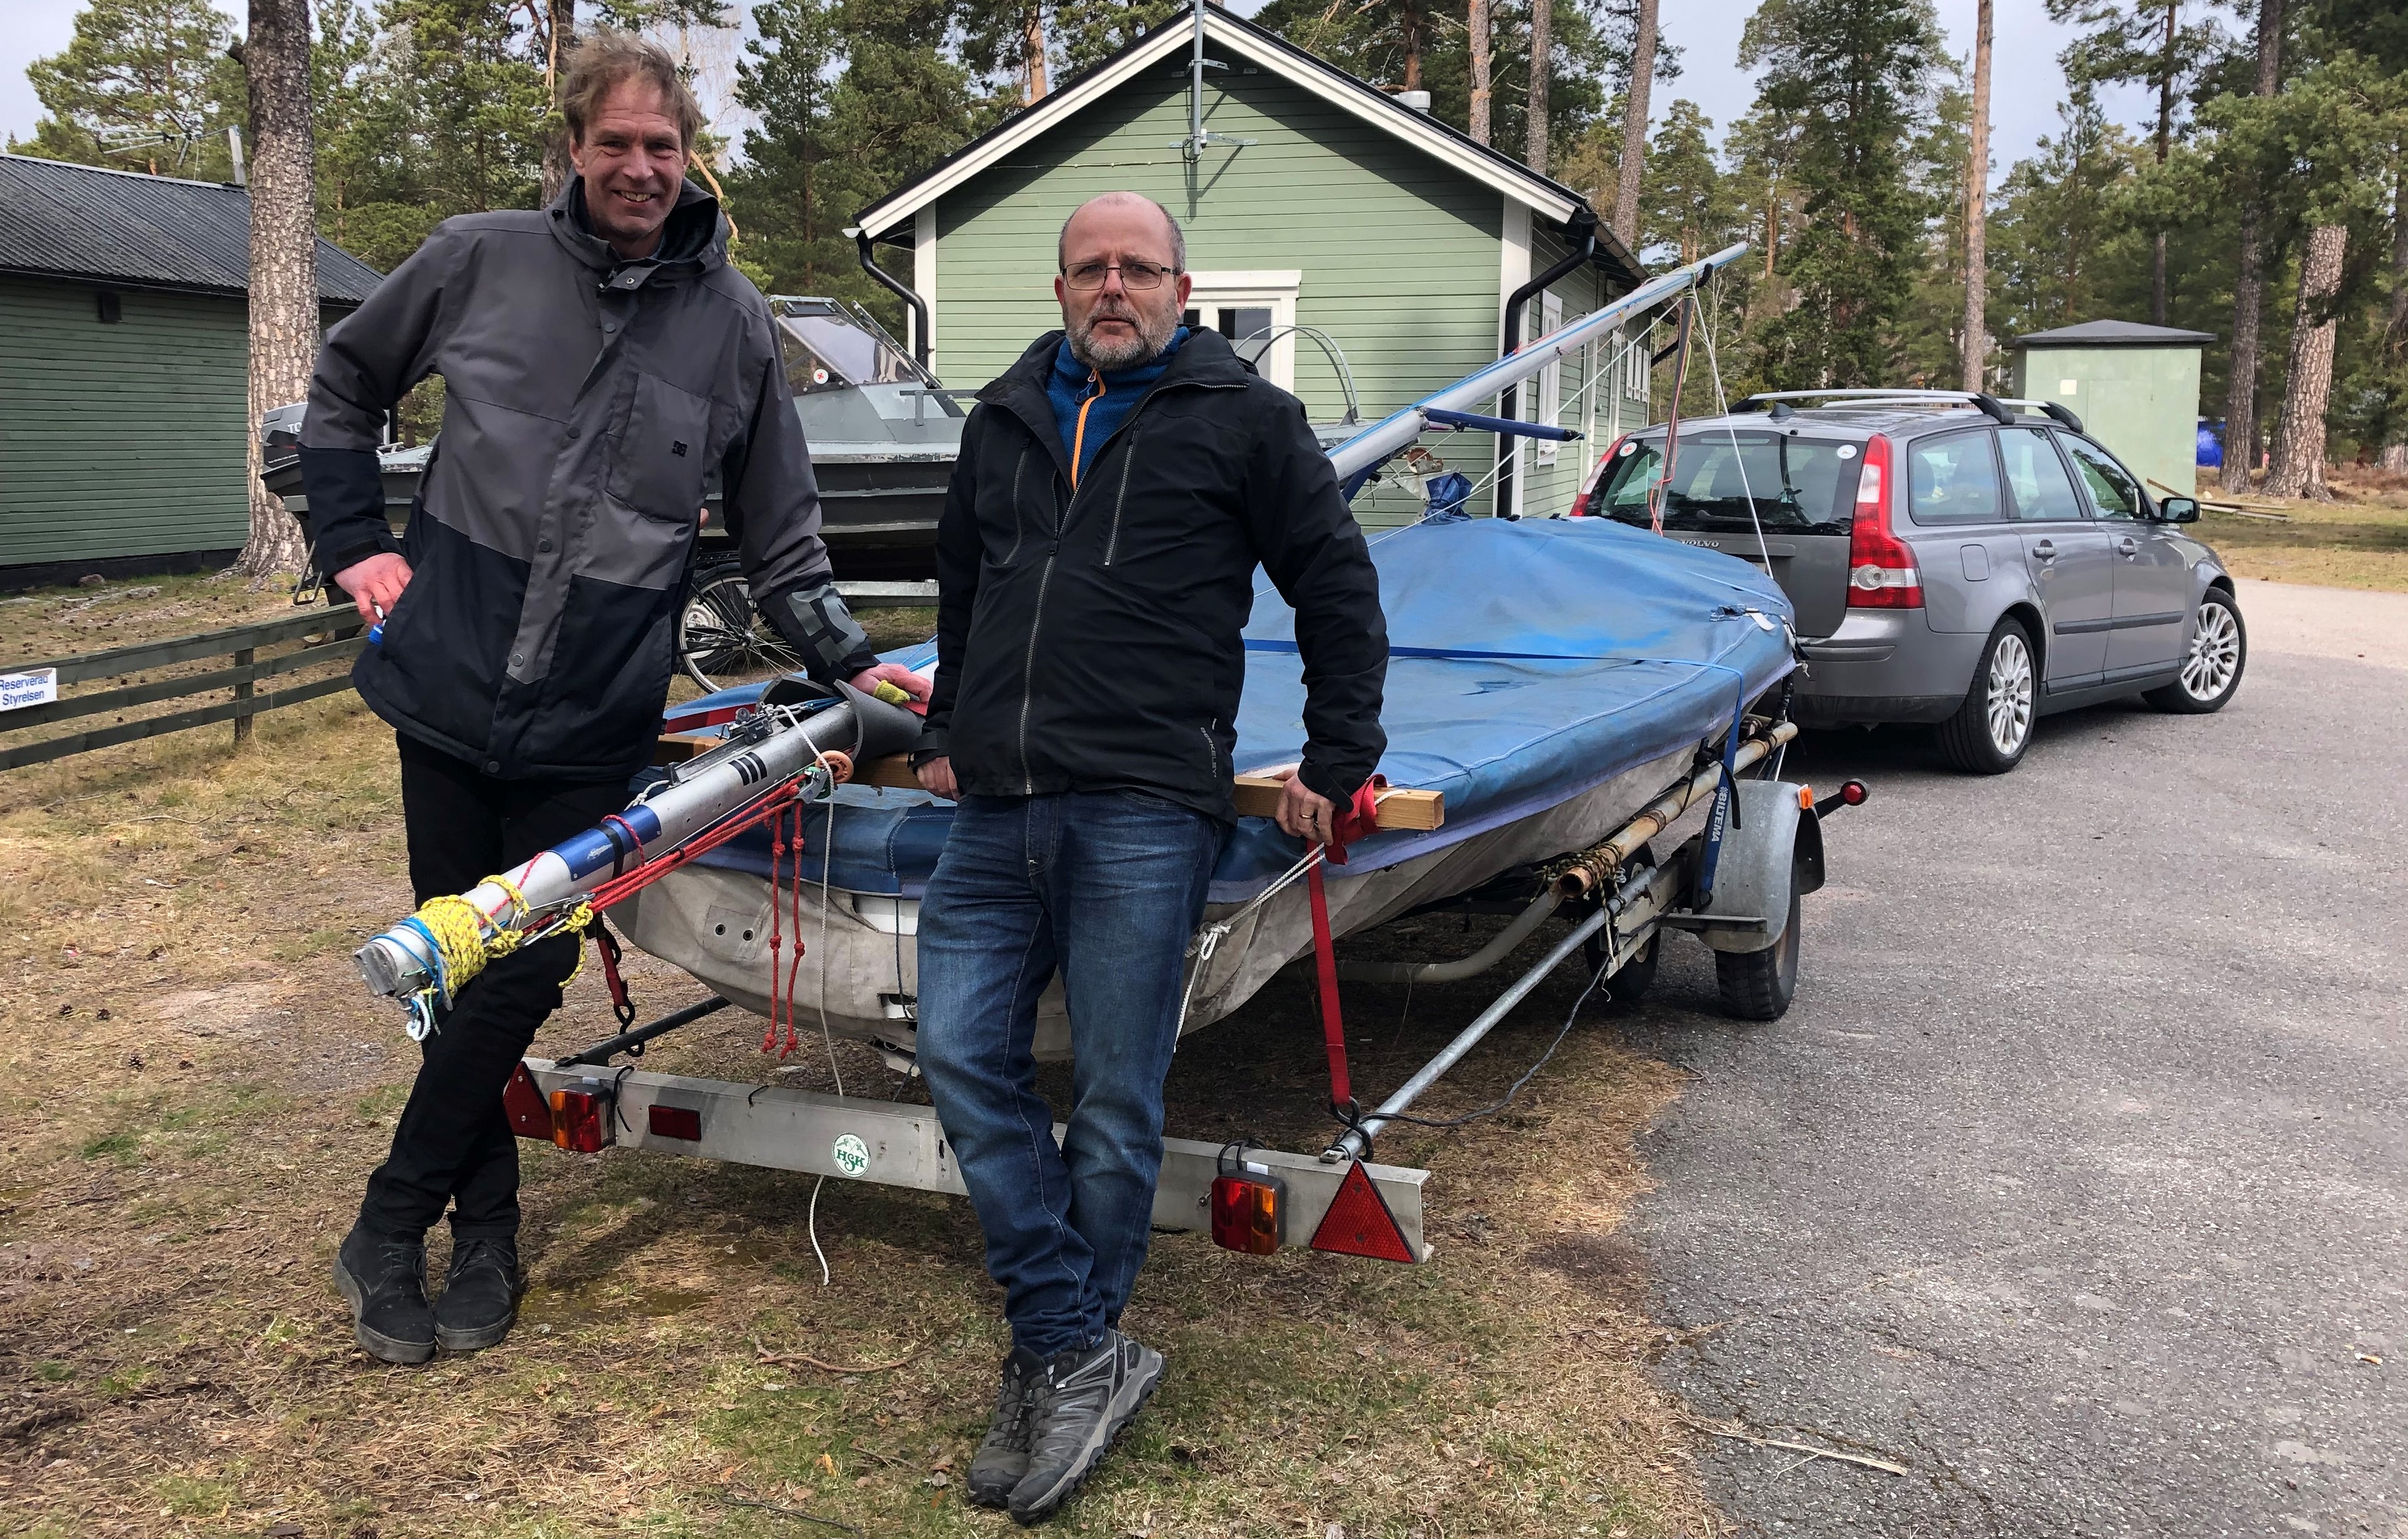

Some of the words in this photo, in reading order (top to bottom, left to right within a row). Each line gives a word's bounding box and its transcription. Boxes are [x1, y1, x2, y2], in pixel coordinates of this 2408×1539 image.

[3, 690, 45, 707] Styrelsen
[1711, 792, 1727, 842] BILTEMA
[836, 1149, 865, 1172] HSK
